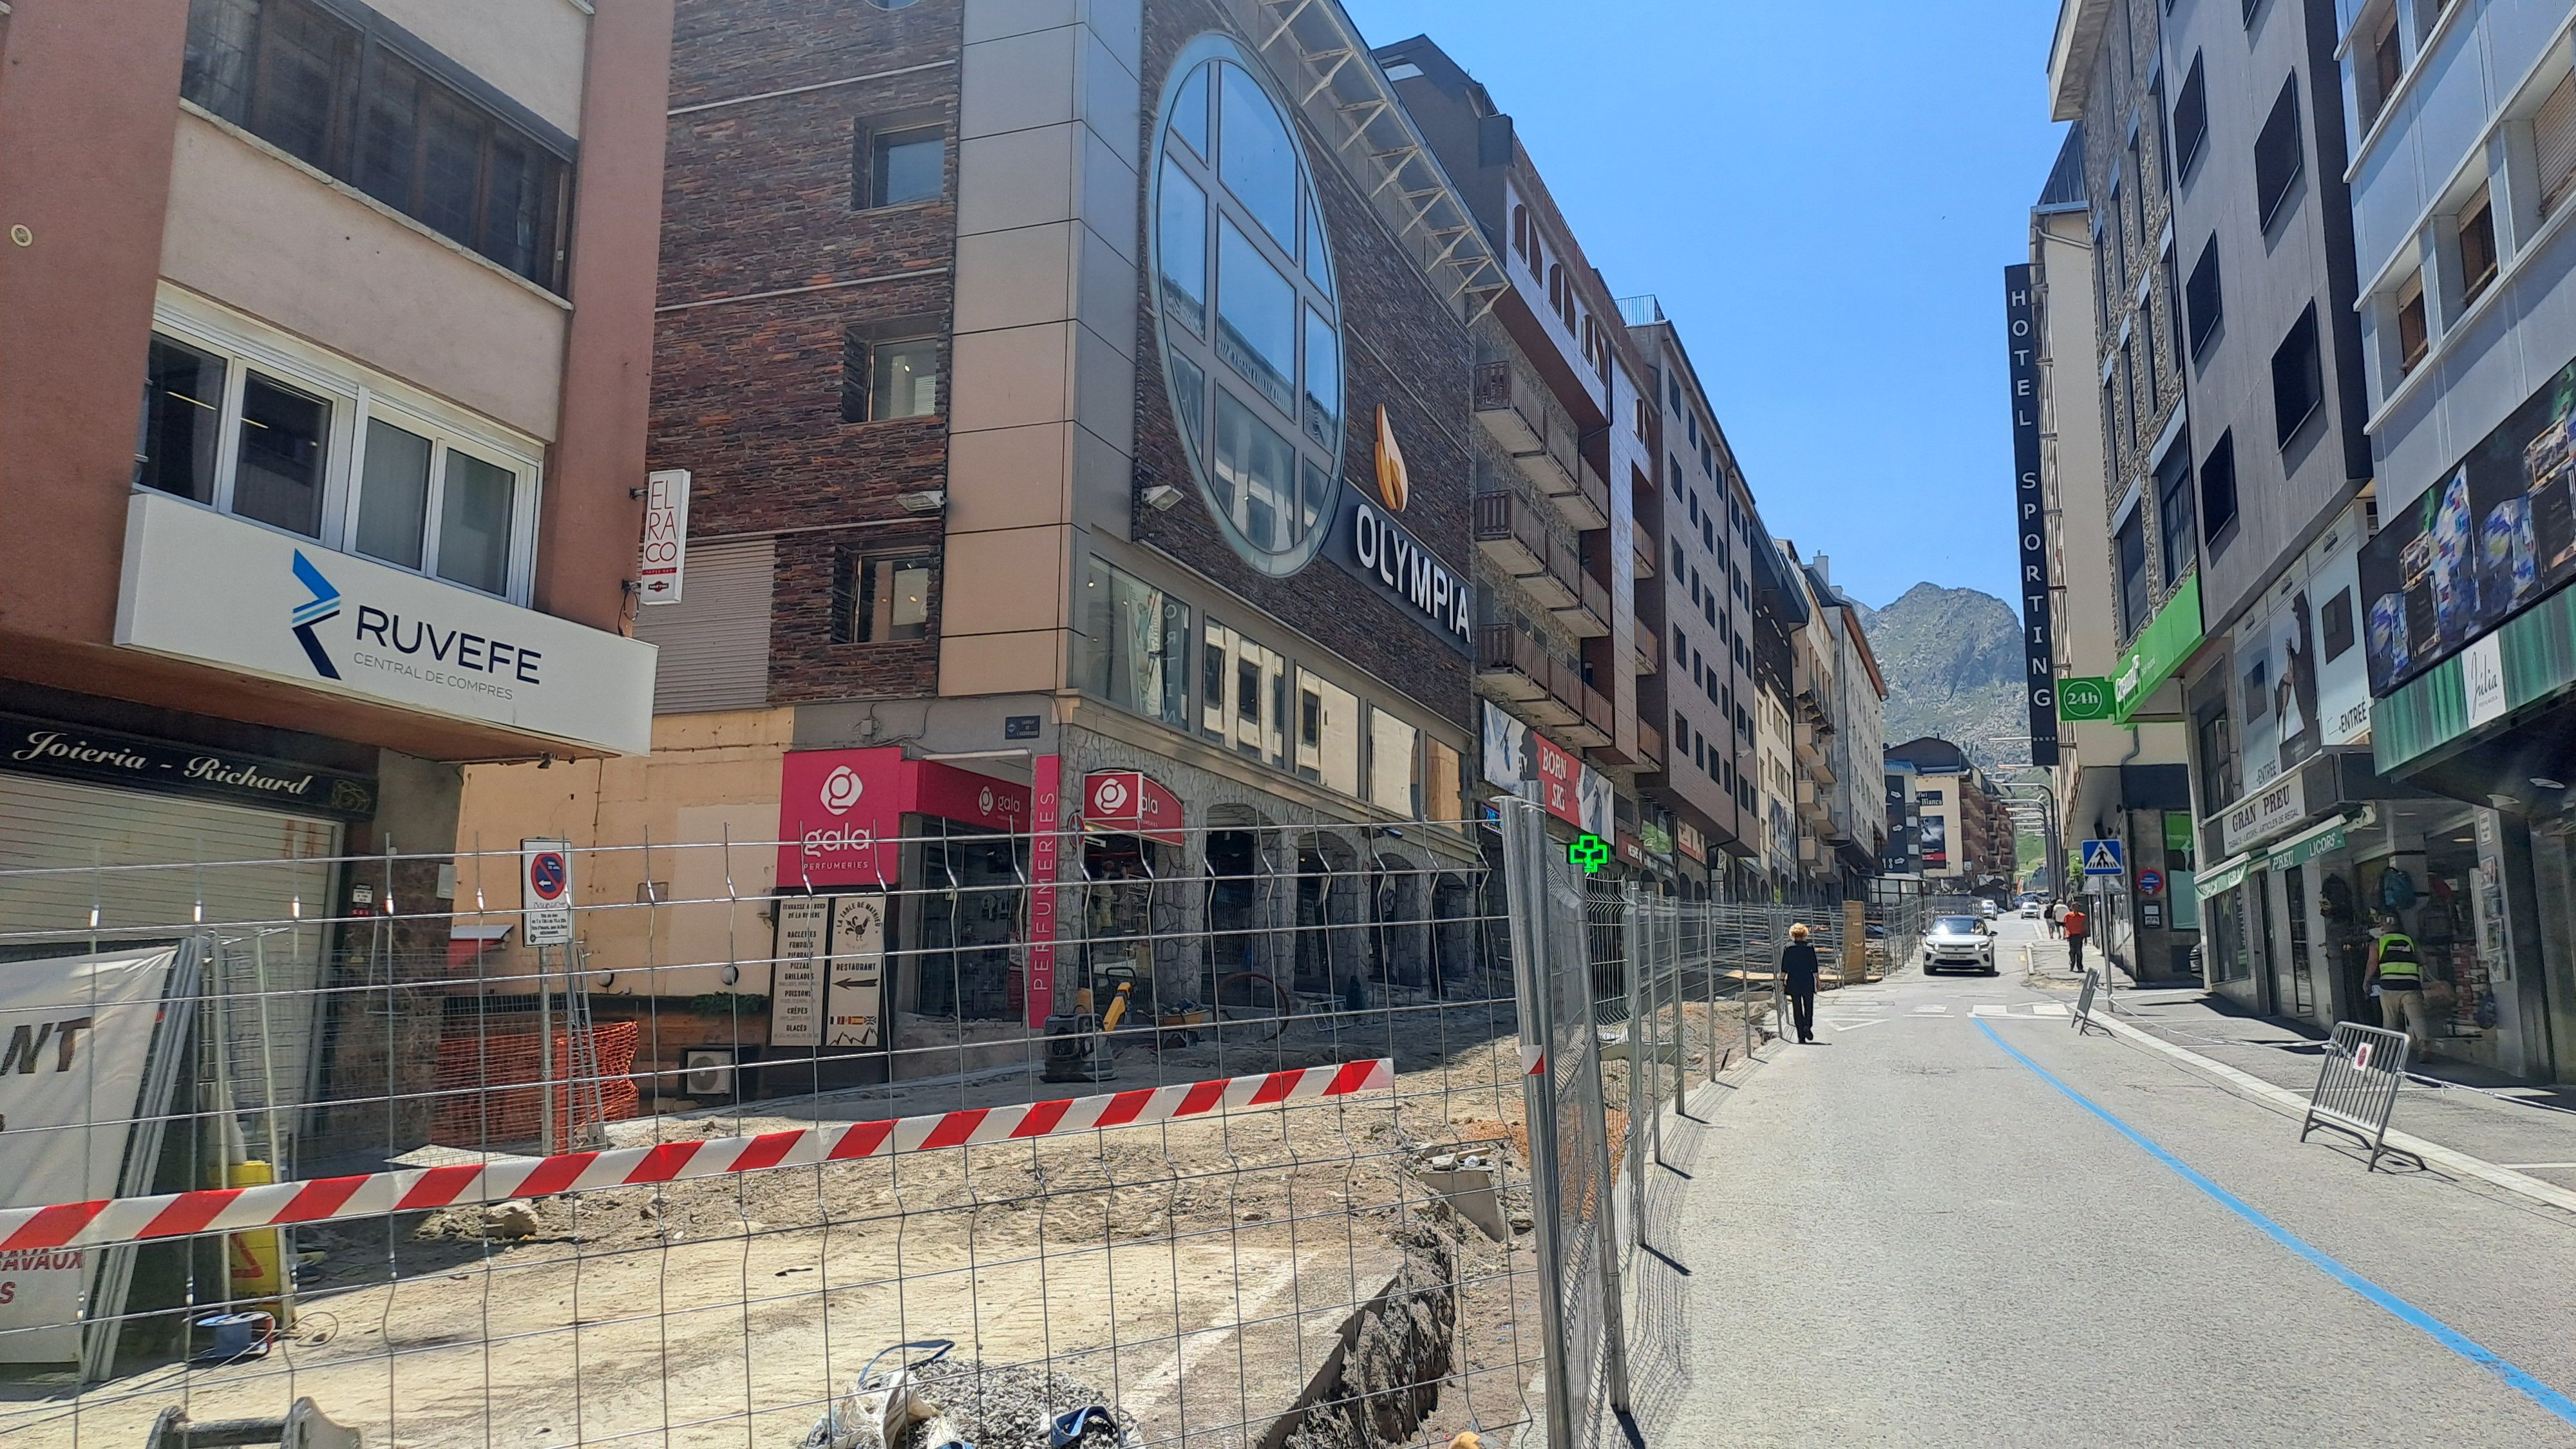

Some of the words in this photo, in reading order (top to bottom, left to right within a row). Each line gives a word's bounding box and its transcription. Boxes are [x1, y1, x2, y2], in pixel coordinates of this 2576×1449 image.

[650, 480, 674, 511] EL
[2011, 289, 2032, 427] HOTEL
[2022, 472, 2051, 707] SPORTING
[648, 511, 676, 541] RA
[645, 542, 676, 563] CO
[1356, 504, 1471, 644] OLYMPIA
[357, 605, 542, 685] RUVEFE
[354, 652, 422, 679] CENTRAL
[426, 670, 444, 684] DE
[448, 675, 513, 700] COMPRES
[2067, 692, 2099, 705] 24h
[12, 730, 149, 771] Joieria
[184, 755, 314, 796] Richard
[1542, 746, 1567, 781] BORN
[998, 794, 1020, 812] gala
[1142, 792, 1158, 815] ala
[2232, 803, 2257, 833] GRAN
[2262, 784, 2290, 817] PREU
[804, 822, 870, 858] gala
[2271, 849, 2294, 871] PREU
[2308, 832, 2336, 857] LICORS
[804, 861, 869, 871] PERFUMERIES
[1034, 792, 1056, 990] PERFUMERIES
[836, 963, 876, 971] RESTAURANT
